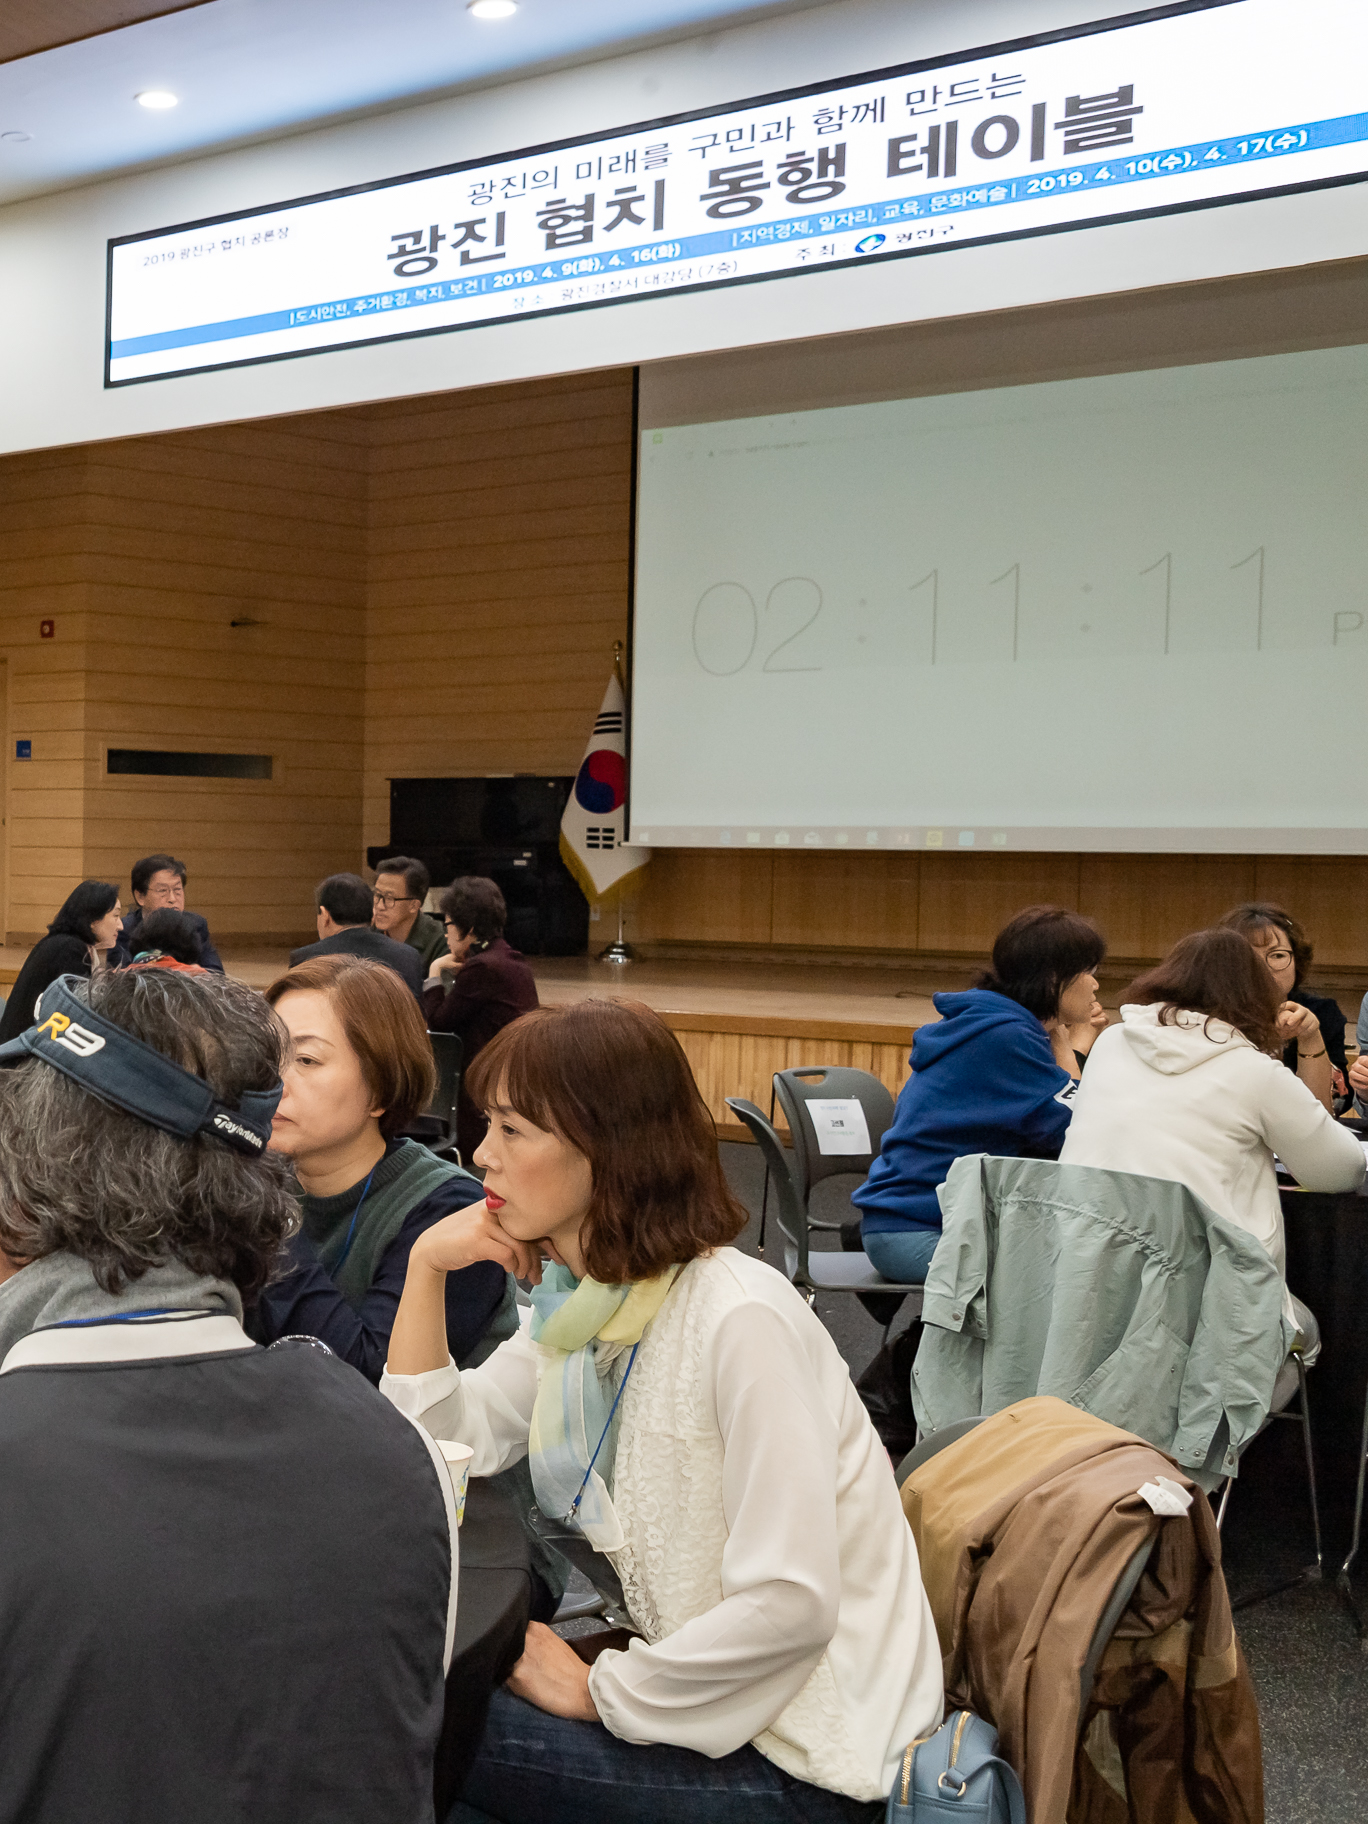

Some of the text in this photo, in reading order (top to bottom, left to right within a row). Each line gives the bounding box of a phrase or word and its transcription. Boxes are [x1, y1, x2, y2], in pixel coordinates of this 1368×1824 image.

[386, 83, 1144, 278] 광진 협치 동행 테이블
[467, 72, 1027, 206] 광진의 미래를 구민과 함께 만드는
[740, 129, 1309, 244] 지역경제, 일자리, 교육, 문화예술 2019. 4. 10(수), 4. 17(수)
[143, 251, 176, 267] 2019
[296, 304, 351, 323] 도시안전,
[450, 279, 478, 296] 보건
[493, 268, 538, 288] 2019.
[542, 264, 558, 279] 4.
[608, 253, 625, 267] 4.
[631, 242, 681, 264] 16(화)
